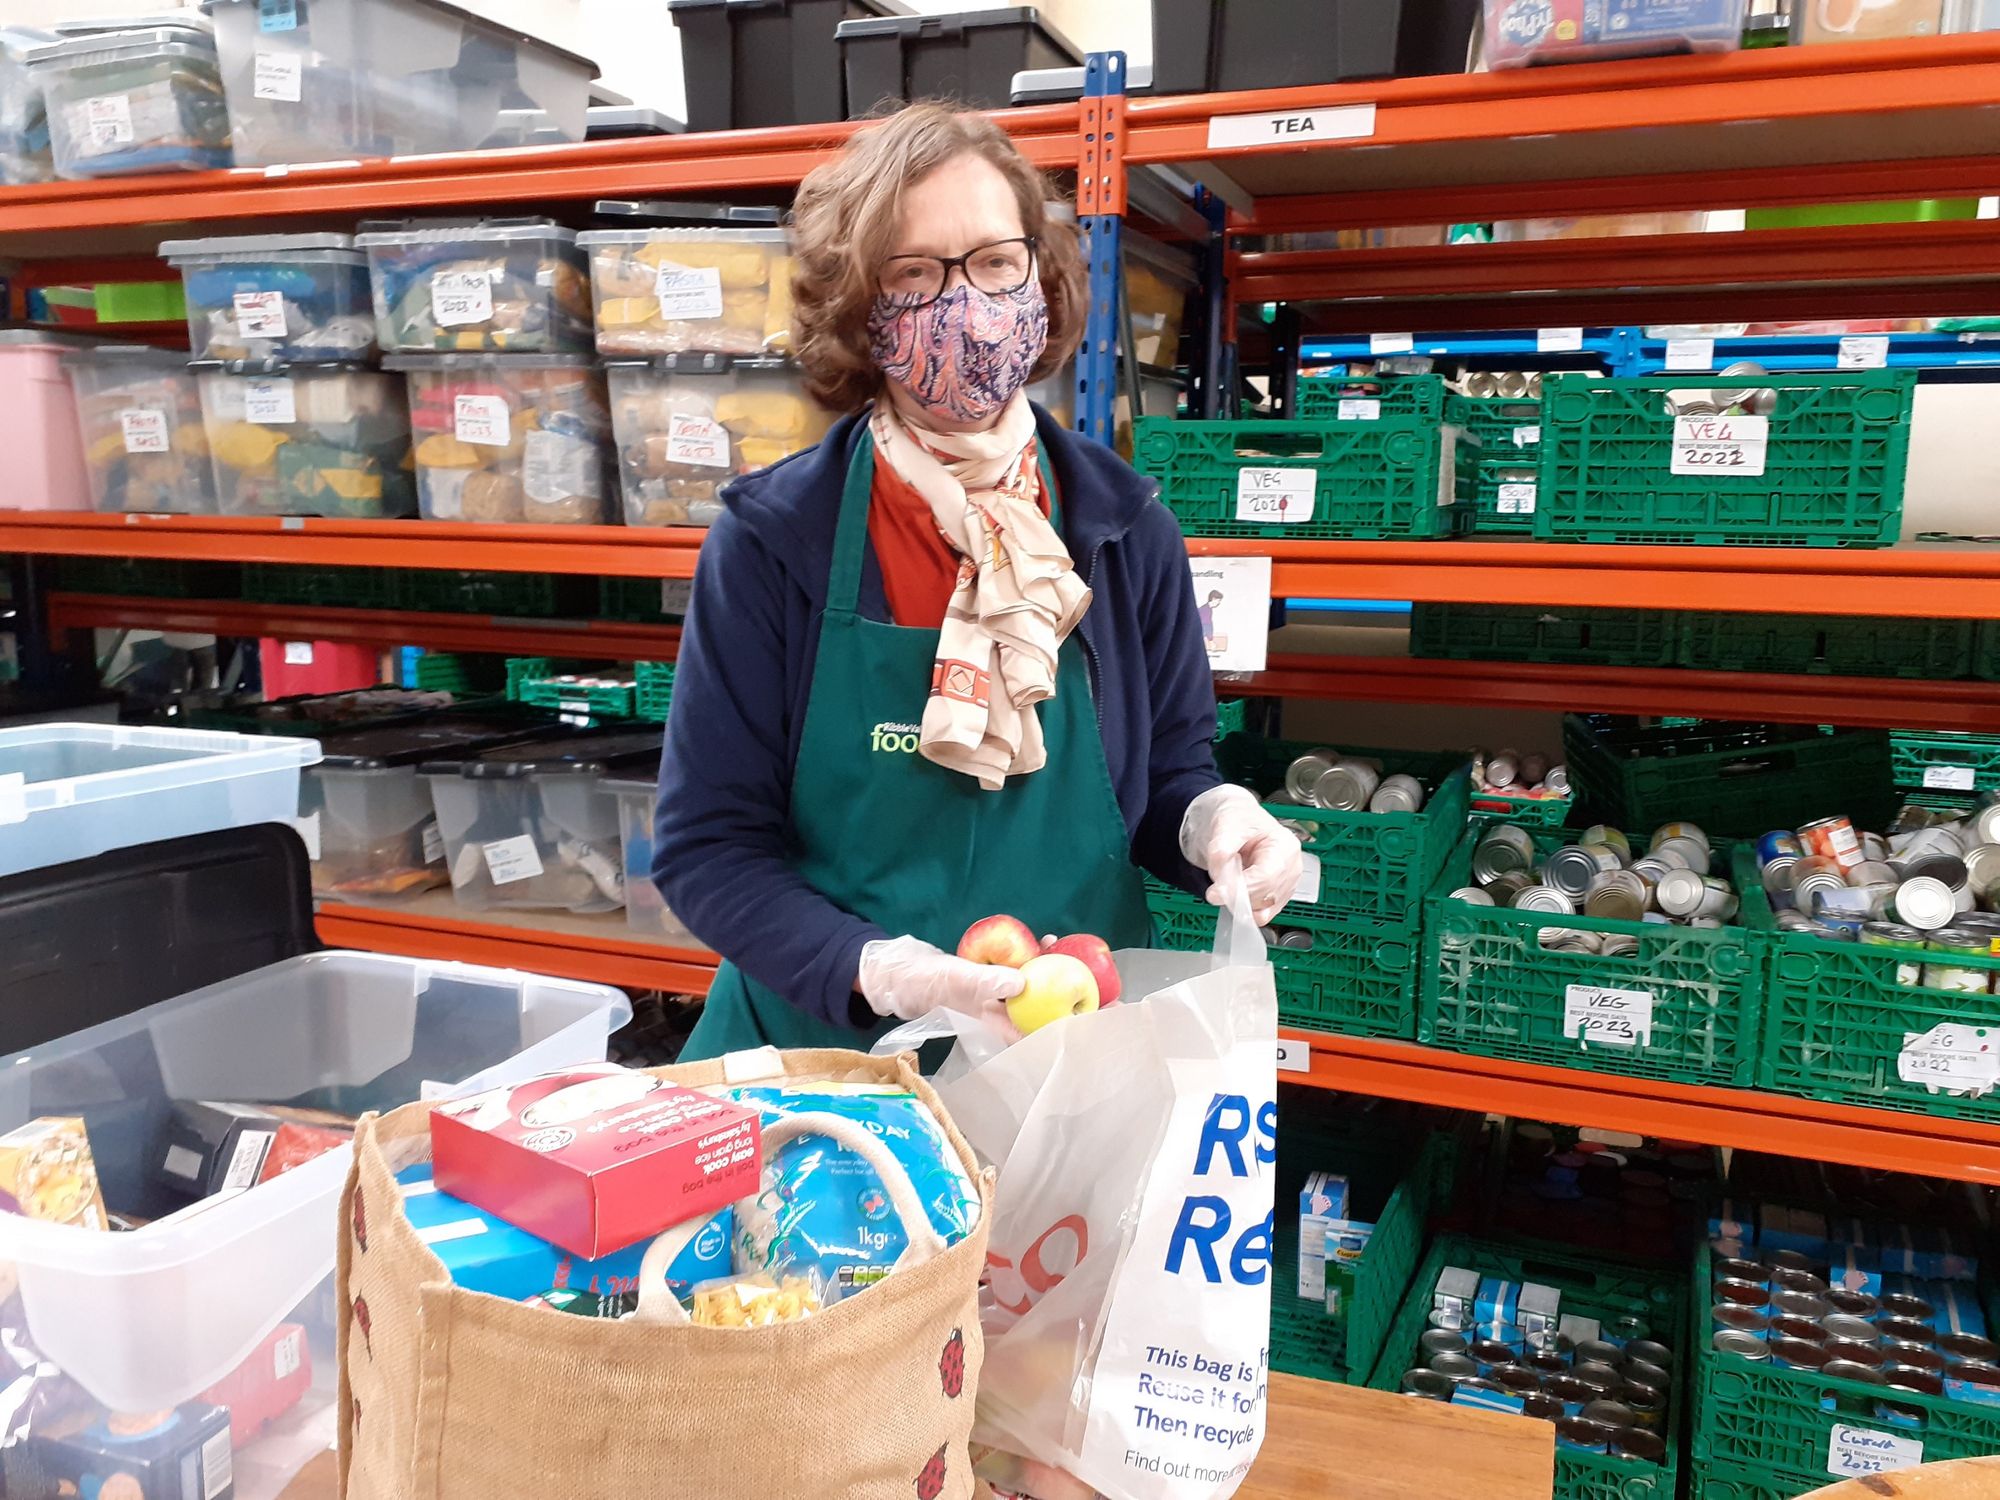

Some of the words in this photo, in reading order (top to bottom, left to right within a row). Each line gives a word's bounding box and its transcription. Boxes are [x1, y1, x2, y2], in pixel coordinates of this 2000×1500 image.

[1272, 117, 1315, 134] TEA
[1252, 472, 1281, 488] VEG
[870, 723, 919, 753] foo
[1589, 993, 1630, 1009] VEG
[1579, 1016, 1634, 1039] 2023
[1931, 1034, 1953, 1048] EG
[731, 1147, 755, 1164] easy
[702, 1157, 730, 1175] cook
[1146, 1346, 1188, 1369] This
[1193, 1354, 1233, 1382] bag
[1237, 1361, 1253, 1382] is
[1138, 1372, 1205, 1405] Reuse
[1211, 1387, 1226, 1409] it
[1134, 1405, 1188, 1436] Then
[1194, 1423, 1254, 1451] recycle
[1836, 1446, 1853, 1456] BEST
[1854, 1450, 1879, 1460] BEFORE
[1880, 1456, 1898, 1464] DATE
[1841, 1453, 1883, 1472] 2022
[1124, 1449, 1161, 1473] Find
[1163, 1462, 1191, 1480] out
[1194, 1466, 1229, 1484] more
